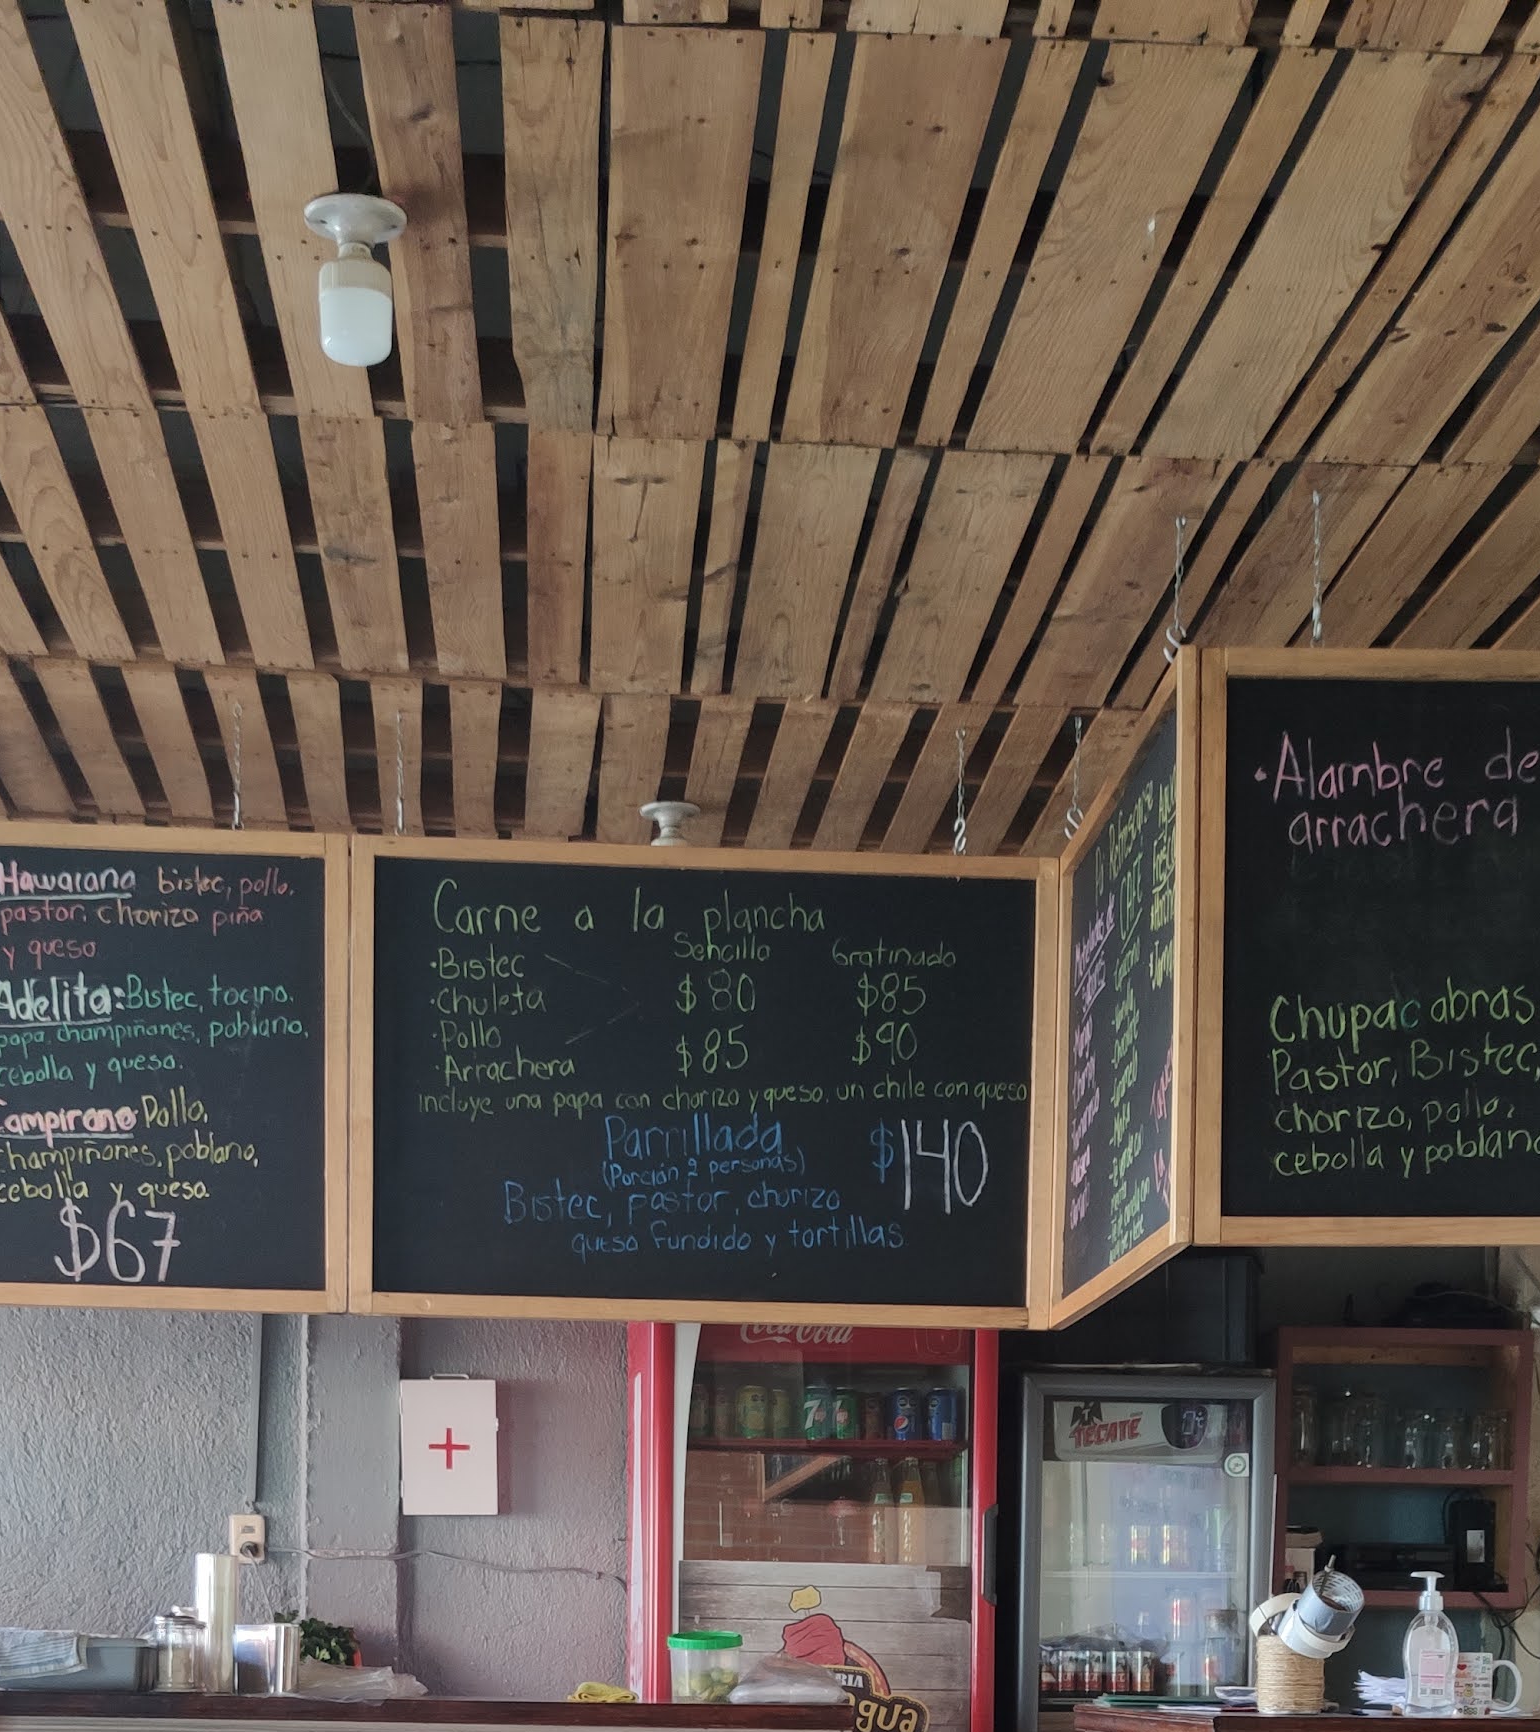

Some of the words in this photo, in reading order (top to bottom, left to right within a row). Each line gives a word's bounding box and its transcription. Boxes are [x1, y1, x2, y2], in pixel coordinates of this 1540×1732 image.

[1273, 730, 1445, 801] Alambre
[1485, 727, 1539, 784] de
[1289, 784, 1518, 854] arrachera
[434, 878, 541, 935] Carne
[575, 904, 594, 931] a
[633, 887, 664, 932] la
[703, 889, 825, 950] plancha
[2, 945, 15, 970] y
[28, 938, 96, 970] queso
[832, 937, 956, 968] Gratinado
[857, 972, 926, 1016] $85
[851, 1020, 918, 1066] $90
[86, 1060, 96, 1090] y
[505, 1093, 541, 1110] una
[553, 1091, 603, 1120] papa
[615, 1093, 651, 1110] con
[662, 1084, 739, 1111] chorizo
[749, 1088, 763, 1113] y
[836, 1084, 864, 1101] un
[873, 1070, 925, 1100] chile
[934, 1081, 969, 1097] con
[974, 1082, 1028, 1110] queso
[605, 1112, 782, 1160] Parrillada
[688, 1158, 697, 1177] 2
[1274, 1138, 1384, 1177] cebolla
[1401, 1147, 1414, 1178] y
[110, 1182, 123, 1201] y
[54, 1198, 181, 1282] $67
[650, 1220, 752, 1251] fundido
[765, 1234, 776, 1256] y
[789, 1214, 904, 1249] tortillas
[1069, 1417, 1142, 1449] TECATE
